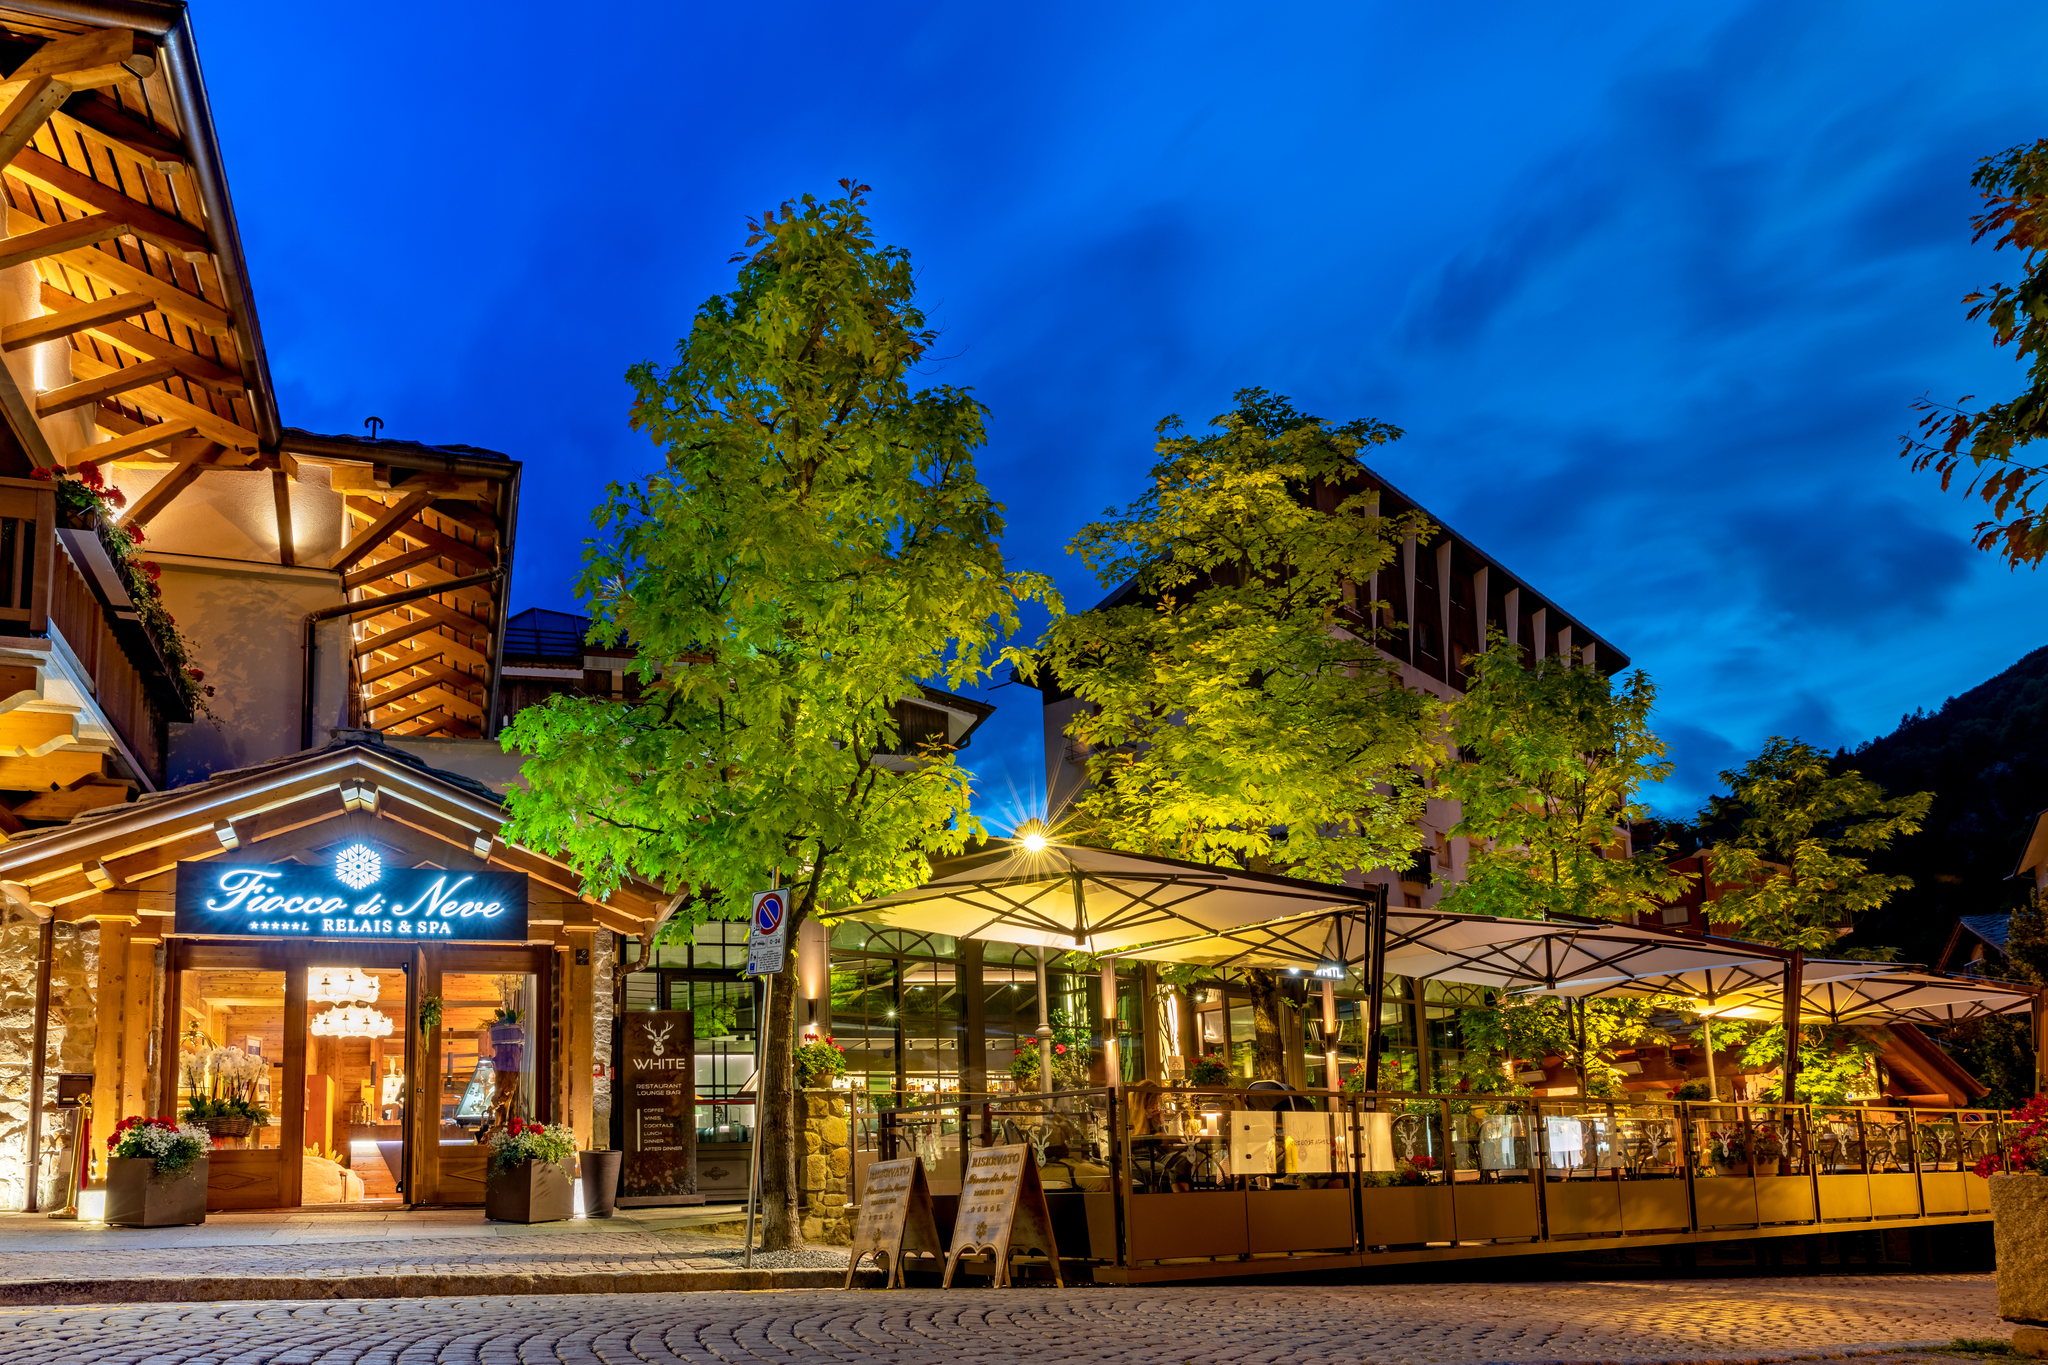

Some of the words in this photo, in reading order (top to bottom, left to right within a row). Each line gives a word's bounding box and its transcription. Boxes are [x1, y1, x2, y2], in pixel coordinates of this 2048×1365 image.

[207, 869, 347, 913] Fiocco
[354, 893, 386, 915] di
[392, 876, 504, 917] Neve
[322, 918, 392, 933] RELAIS
[398, 919, 412, 933] &
[417, 921, 451, 934] SPA
[633, 1058, 686, 1070] WHITE
[971, 1153, 1020, 1168] RISERVATO
[869, 1165, 910, 1180] RISERVATO
